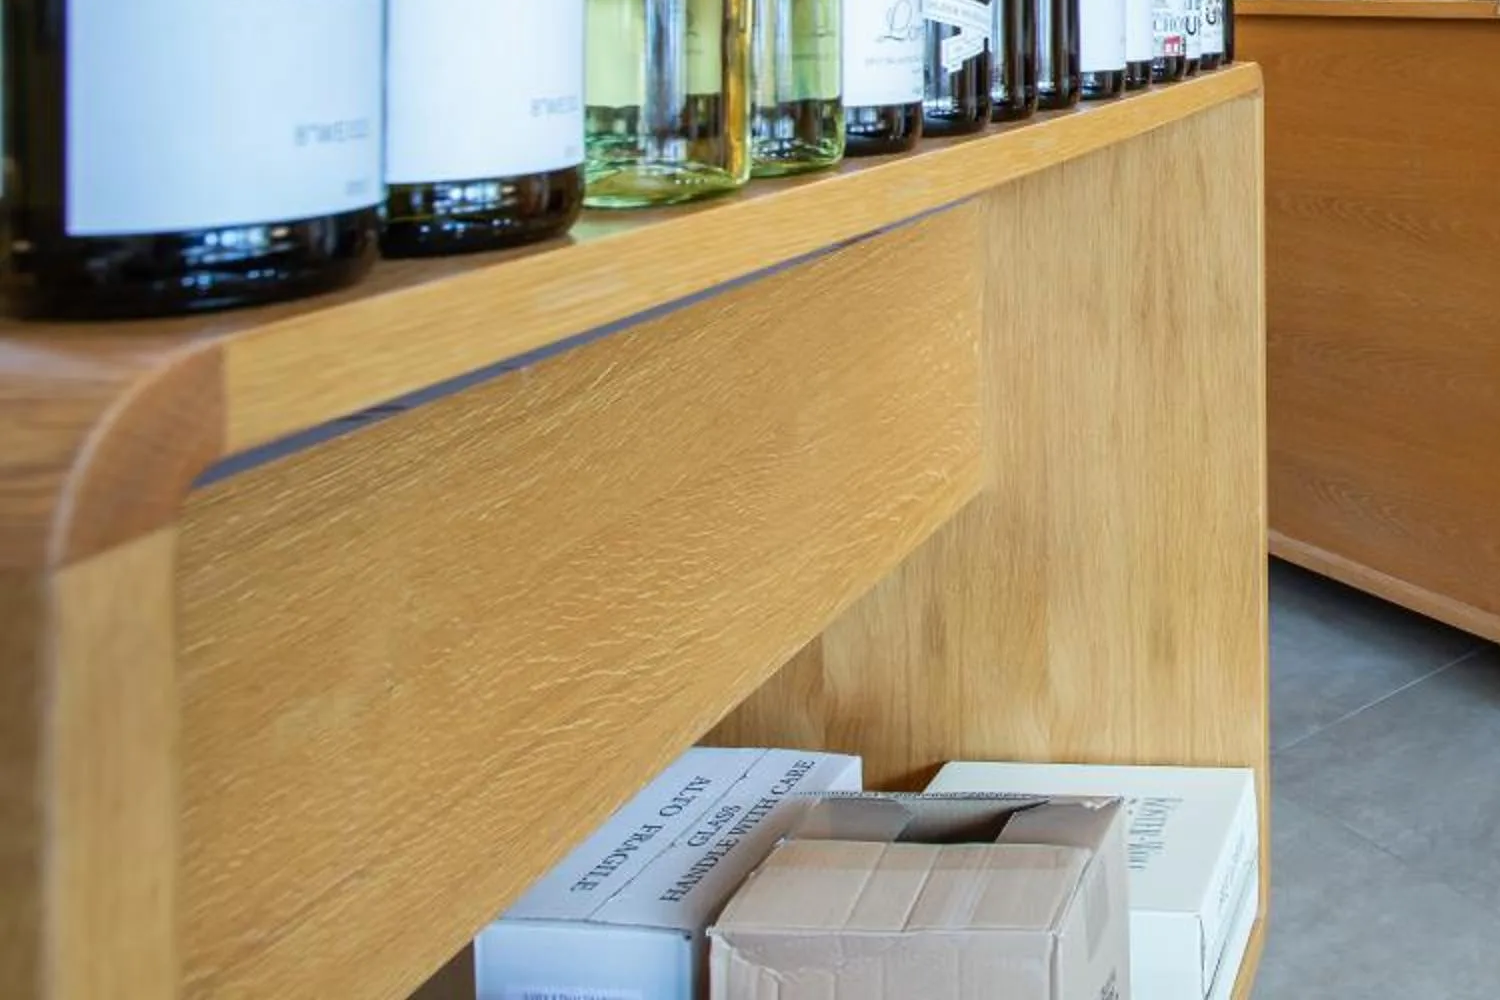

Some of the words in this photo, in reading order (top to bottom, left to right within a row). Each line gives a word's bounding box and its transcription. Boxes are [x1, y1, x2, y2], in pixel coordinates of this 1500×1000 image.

[658, 775, 712, 818] ALTO
[658, 838, 740, 902] HANDLE
[728, 795, 774, 838] WITH
[771, 759, 816, 796] CARE
[686, 804, 742, 848] GLASS
[569, 823, 663, 893] FRAGILE
